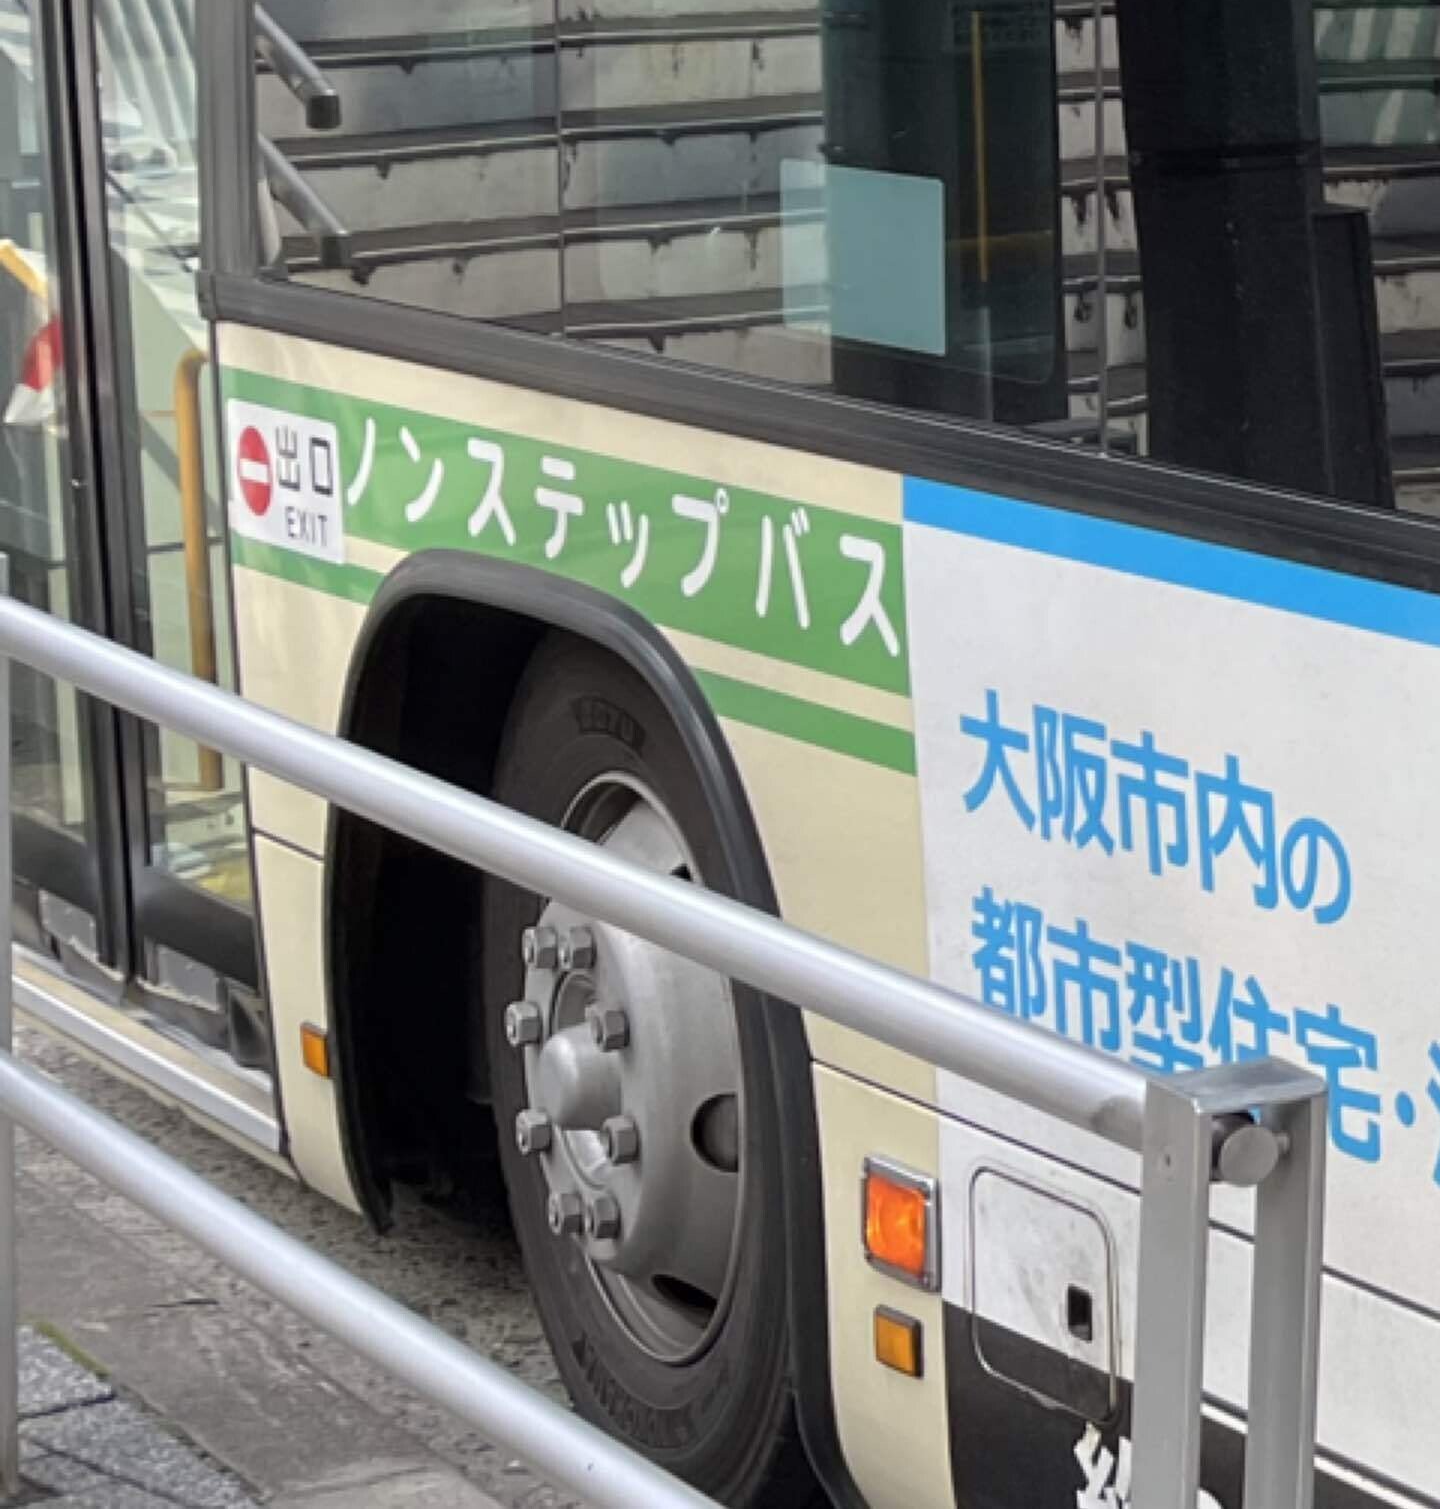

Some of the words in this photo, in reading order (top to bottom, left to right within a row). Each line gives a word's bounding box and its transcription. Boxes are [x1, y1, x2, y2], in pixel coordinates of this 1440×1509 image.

[275, 424, 333, 498] 出口
[285, 505, 328, 547] EXIT
[345, 417, 901, 659] ノンステップバス
[959, 688, 1353, 926] 大阪市内の
